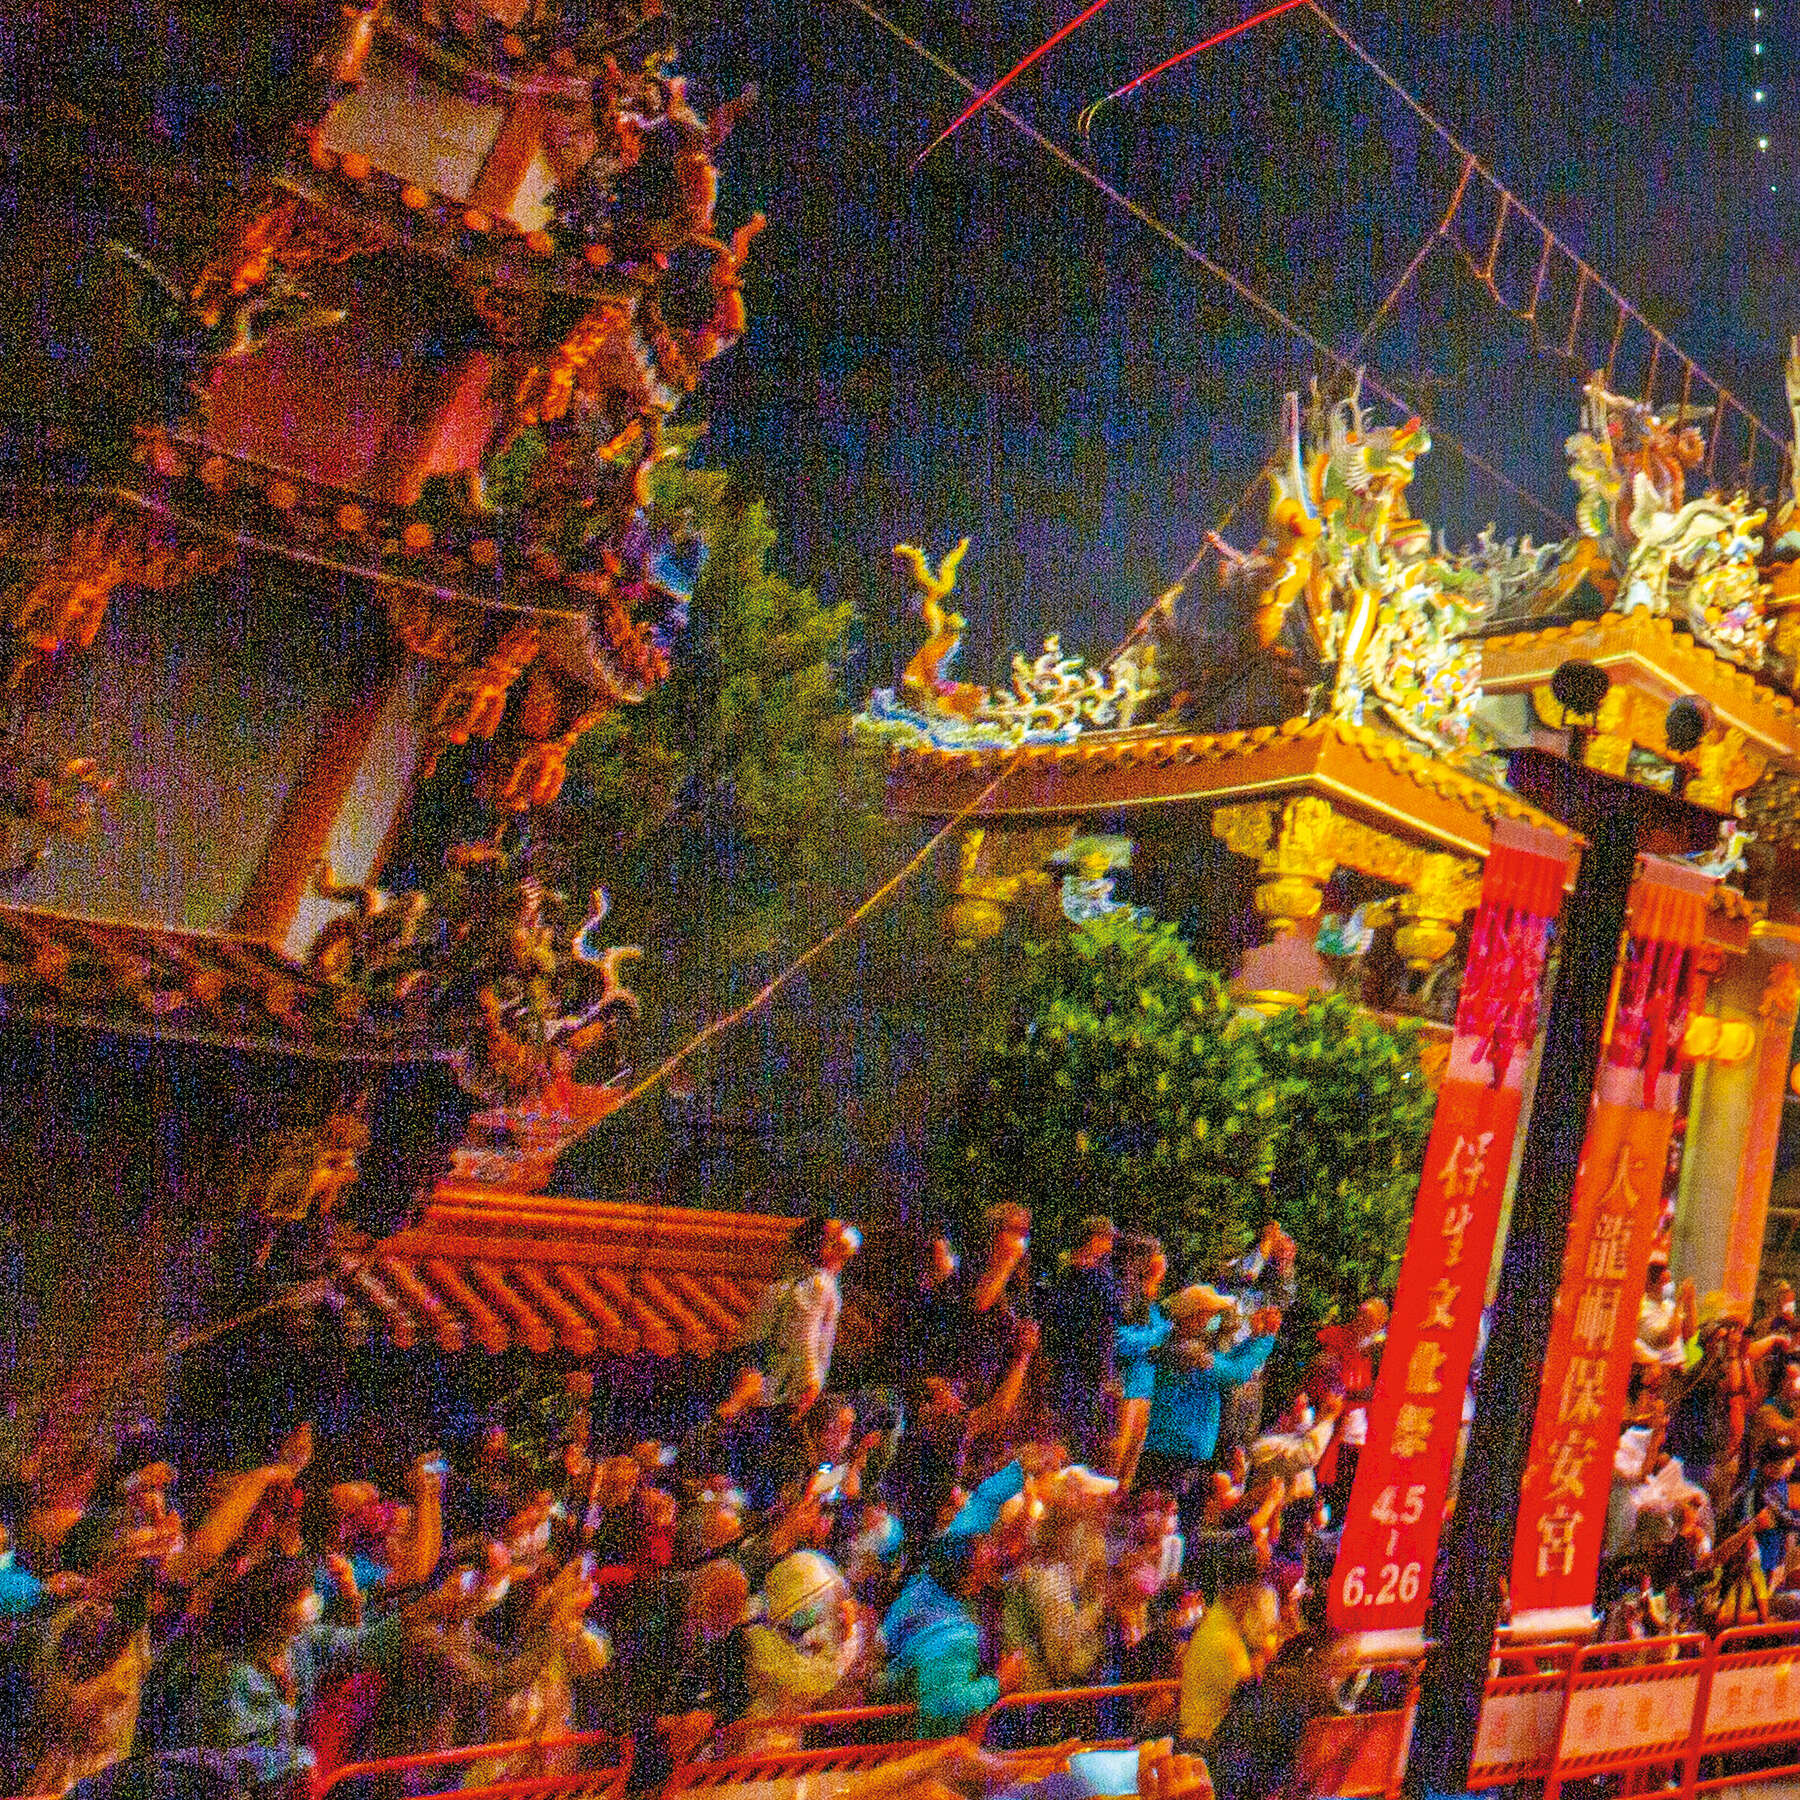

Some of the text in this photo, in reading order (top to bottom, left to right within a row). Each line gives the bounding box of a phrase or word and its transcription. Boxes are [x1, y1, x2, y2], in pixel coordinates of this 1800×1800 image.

[1536, 1143, 1645, 1578] 大龍峒保安宮
[1342, 1561, 1422, 1608] 6.26
